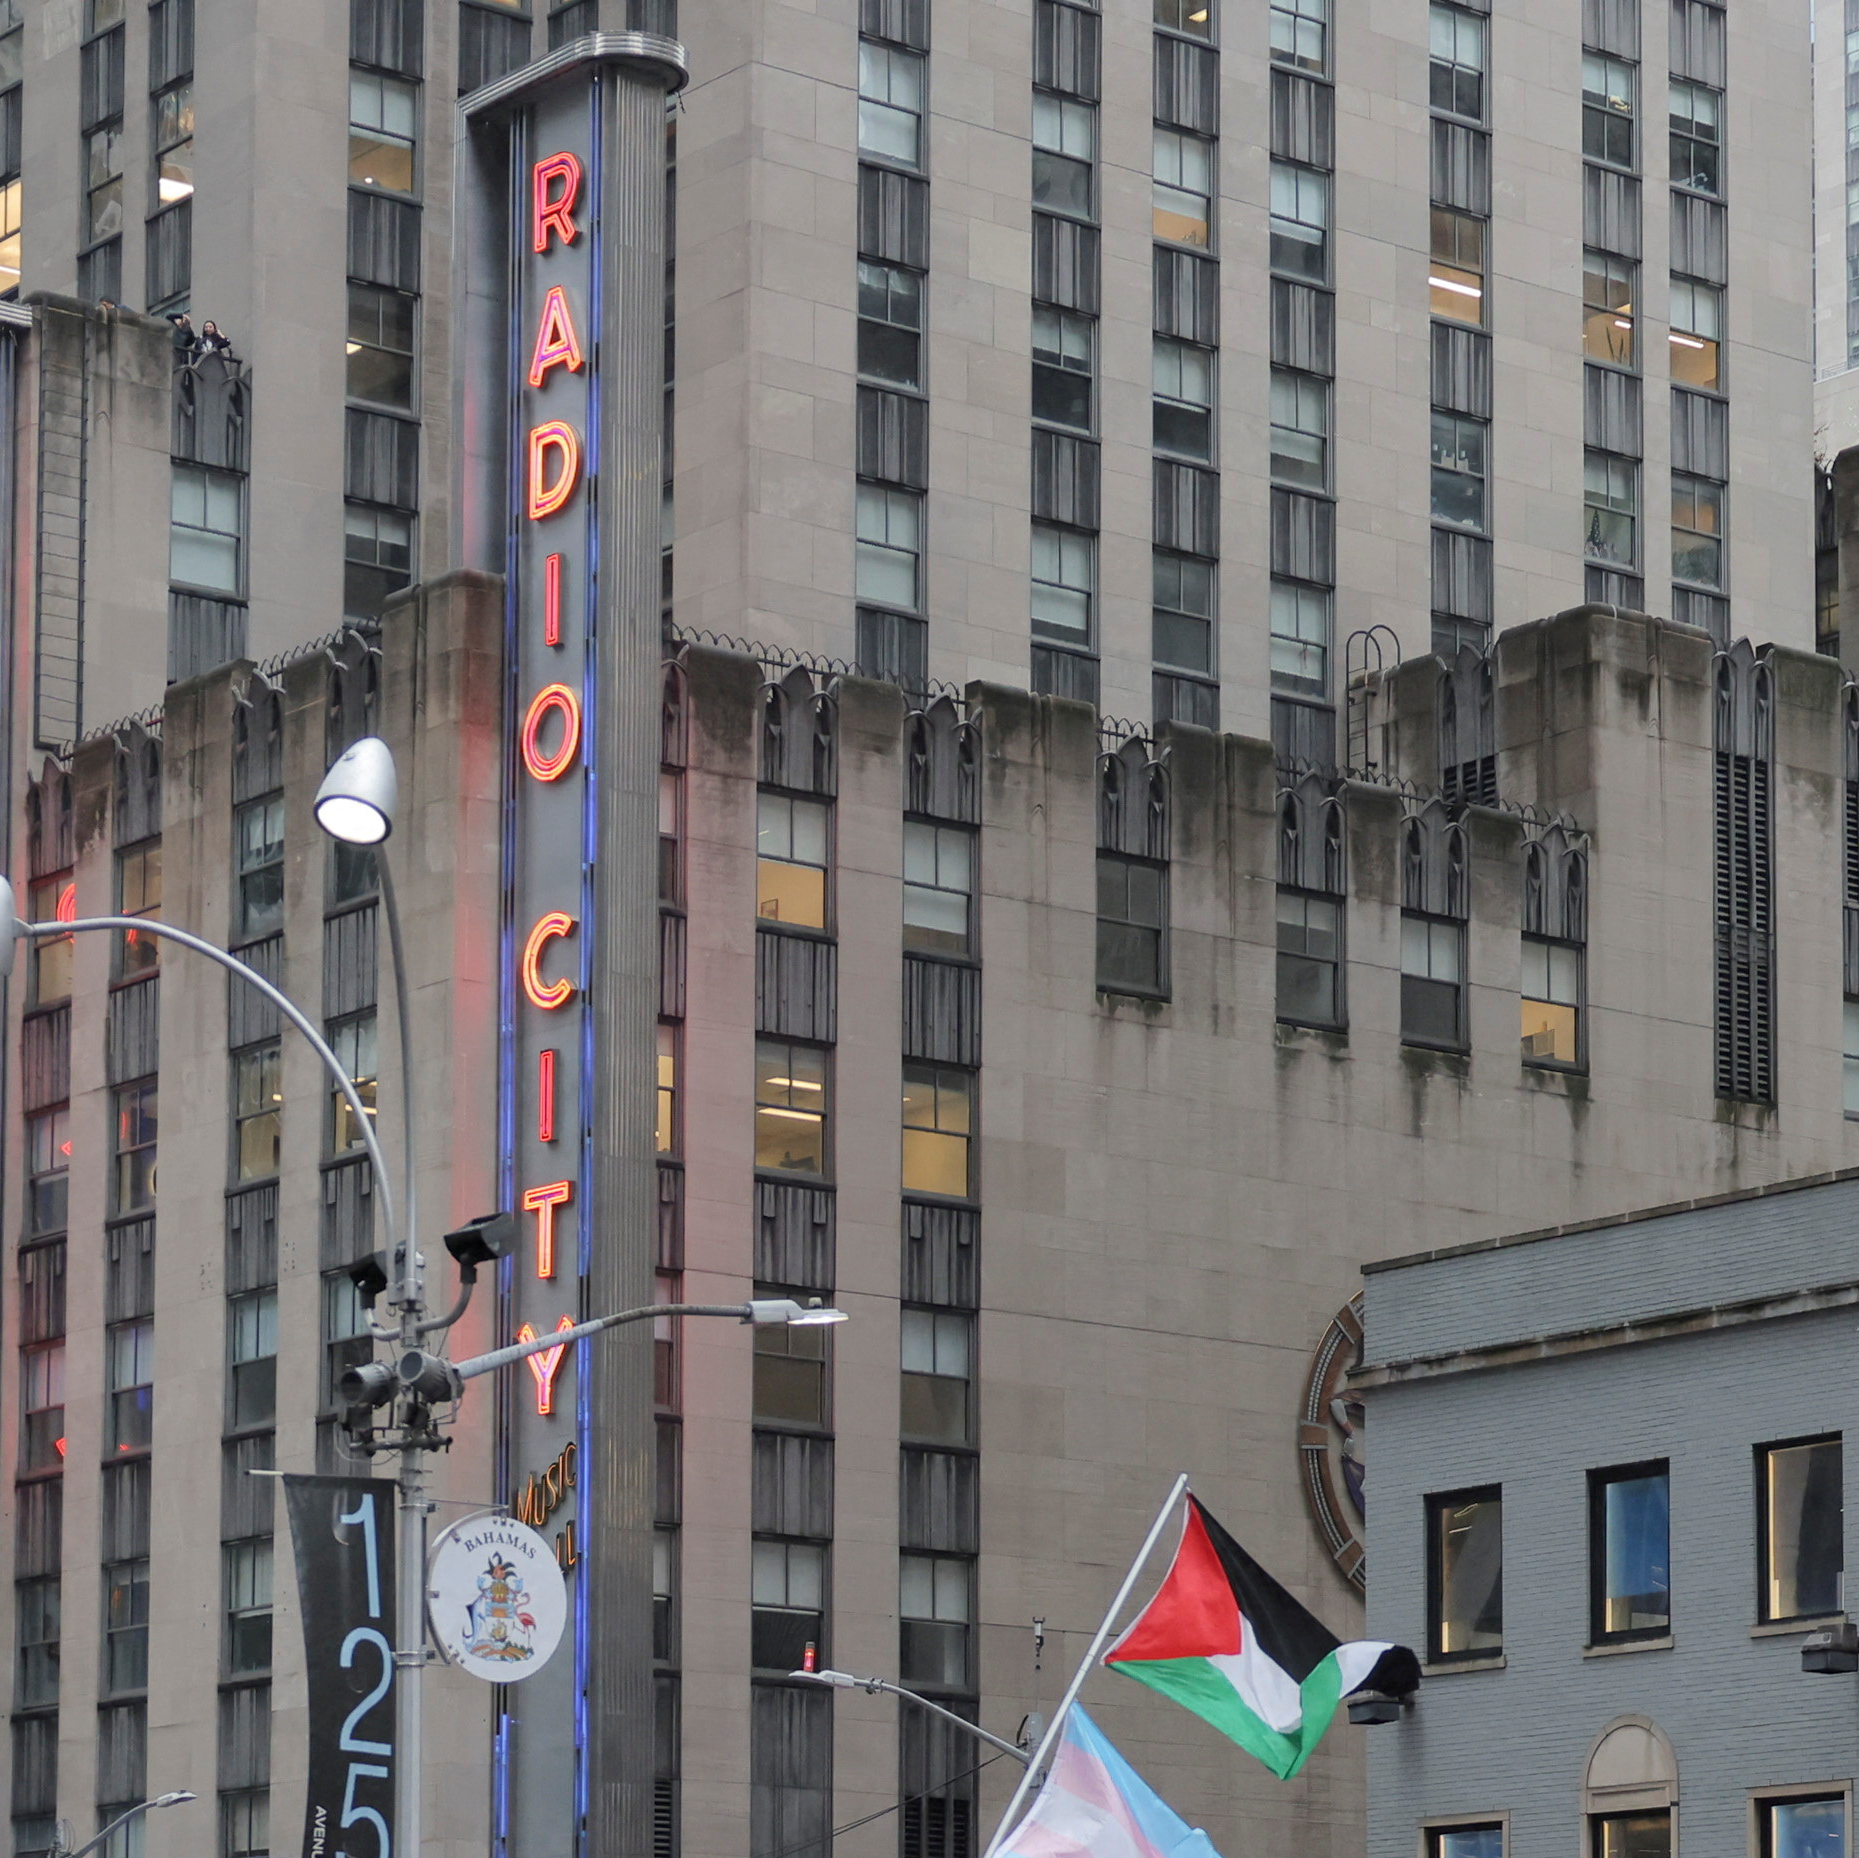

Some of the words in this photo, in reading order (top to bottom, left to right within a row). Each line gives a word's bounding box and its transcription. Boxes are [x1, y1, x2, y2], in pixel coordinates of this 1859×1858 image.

[521, 151, 586, 783] RADIO
[516, 911, 575, 1417] CITY
[465, 1531, 537, 1560] BAHAMAS
[515, 1440, 576, 1527] MUSIC
